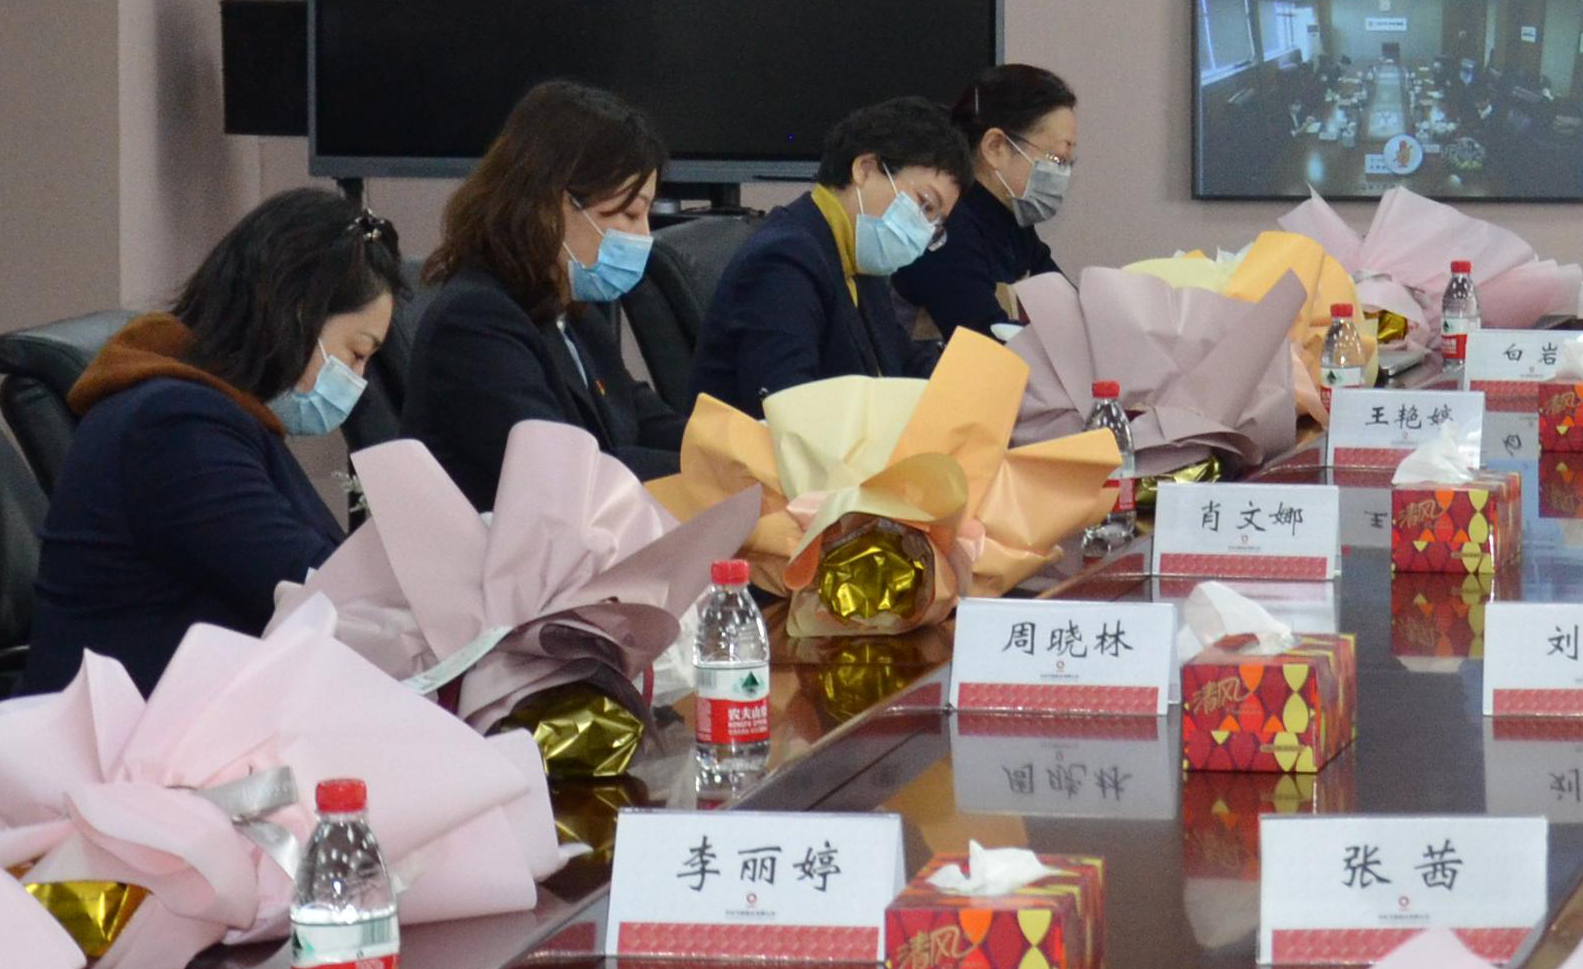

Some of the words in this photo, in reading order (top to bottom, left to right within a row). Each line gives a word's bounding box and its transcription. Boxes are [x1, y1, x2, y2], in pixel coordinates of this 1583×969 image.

[1502, 341, 1558, 366] 白岩
[1200, 501, 1304, 536] 肖文娜
[1002, 619, 1134, 659] 周晓林
[676, 835, 842, 892] 李丽婷
[1341, 839, 1464, 891] 张茜
